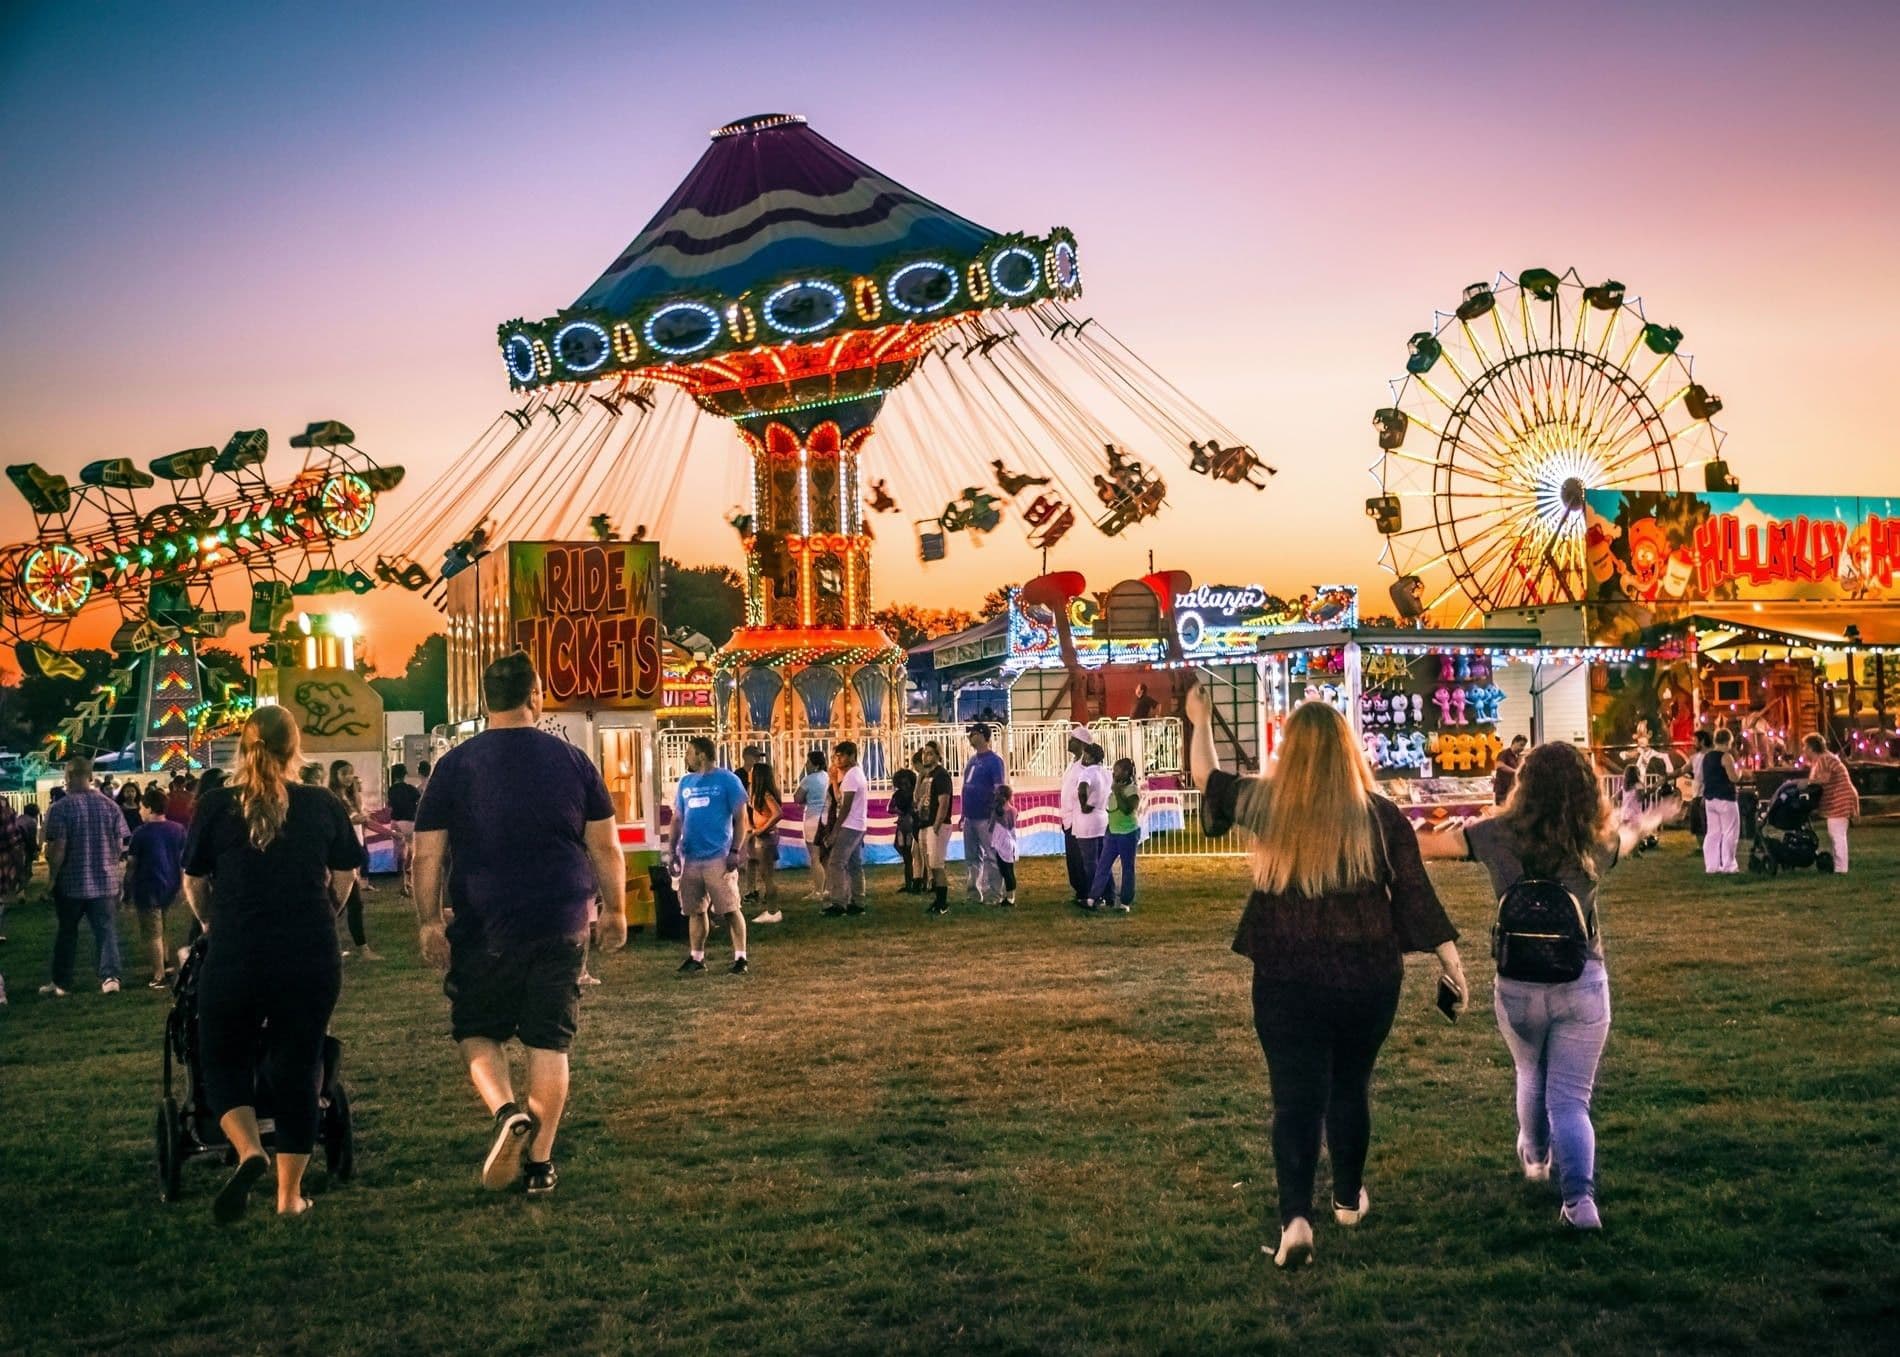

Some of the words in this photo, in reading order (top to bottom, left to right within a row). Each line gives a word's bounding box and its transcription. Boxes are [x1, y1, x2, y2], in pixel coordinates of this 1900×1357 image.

[545, 546, 628, 614] RIDE
[1694, 513, 1848, 595] HILLBILLY
[515, 613, 661, 700] TICKETS
